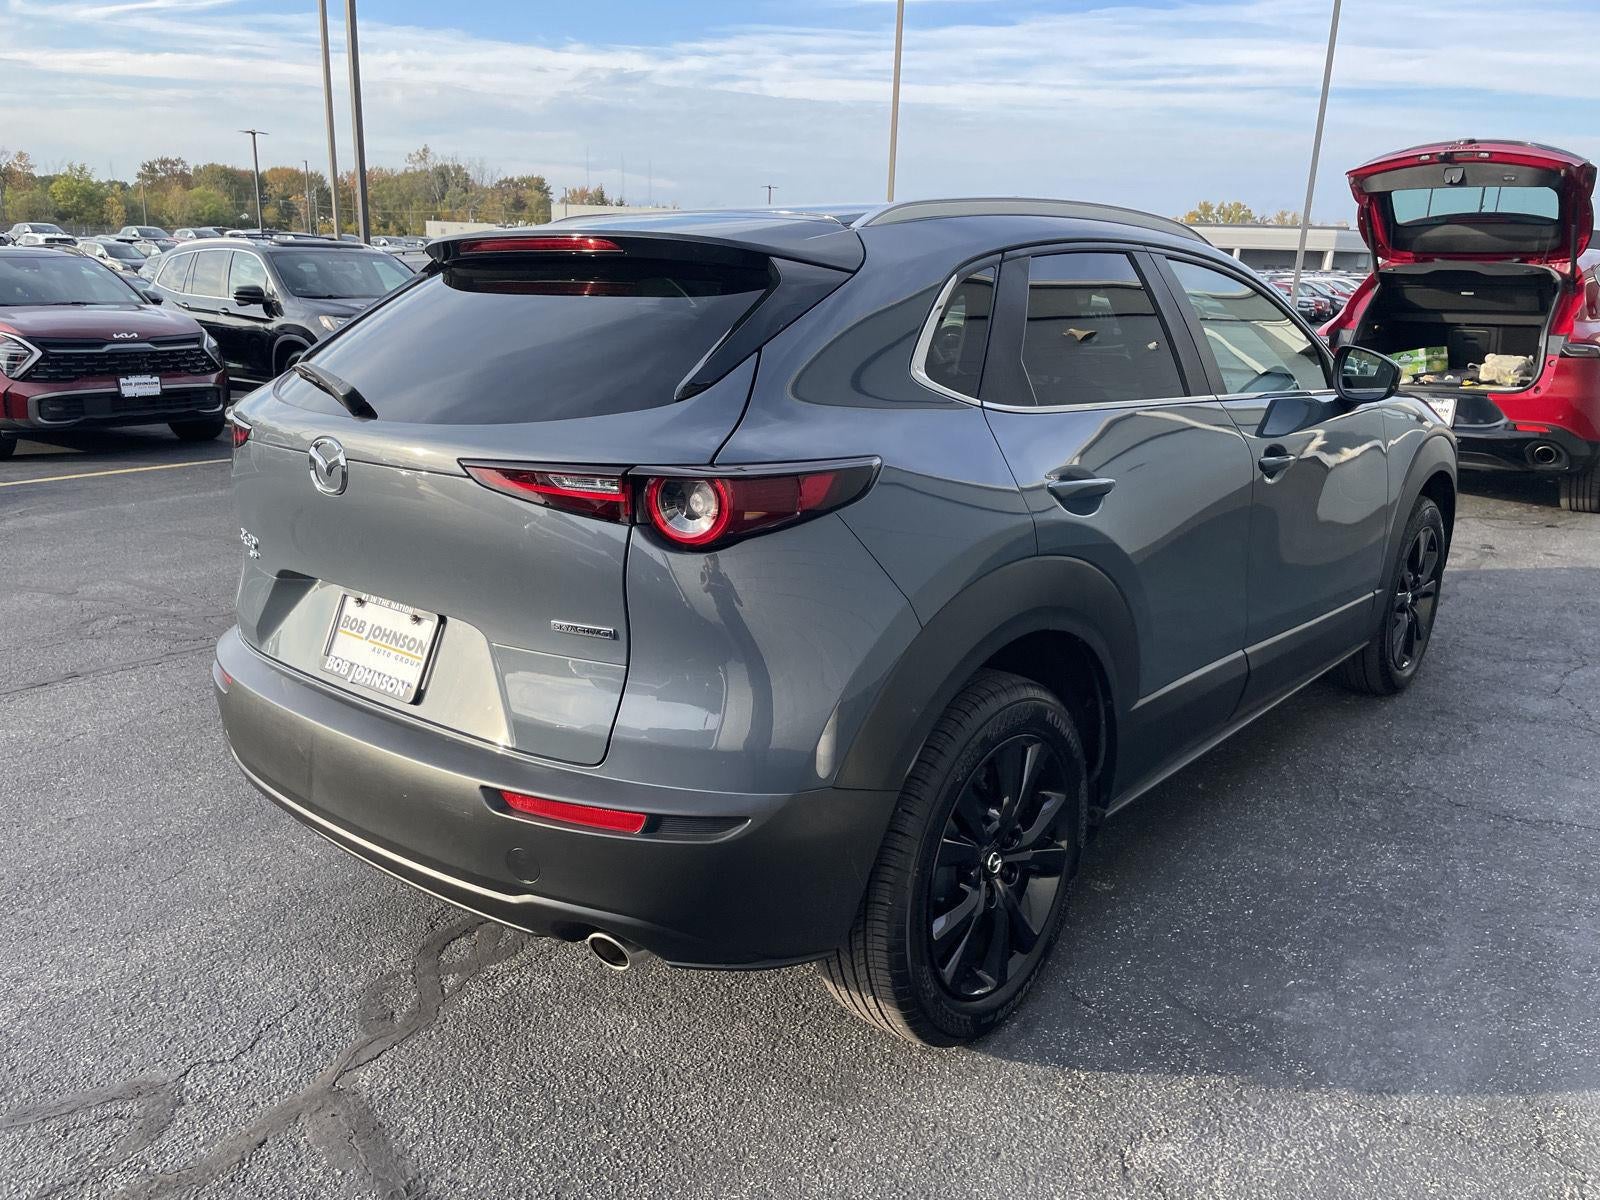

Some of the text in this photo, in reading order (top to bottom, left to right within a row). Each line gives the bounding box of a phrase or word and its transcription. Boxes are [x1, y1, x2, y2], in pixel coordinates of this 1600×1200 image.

[370, 594, 378, 603] IN
[378, 597, 391, 607] THE
[390, 601, 414, 614] NATION
[341, 615, 428, 655] BOB JOHNSON
[371, 646, 421, 669] AUTO GROUP
[324, 655, 408, 697] BOB JOHNSON
